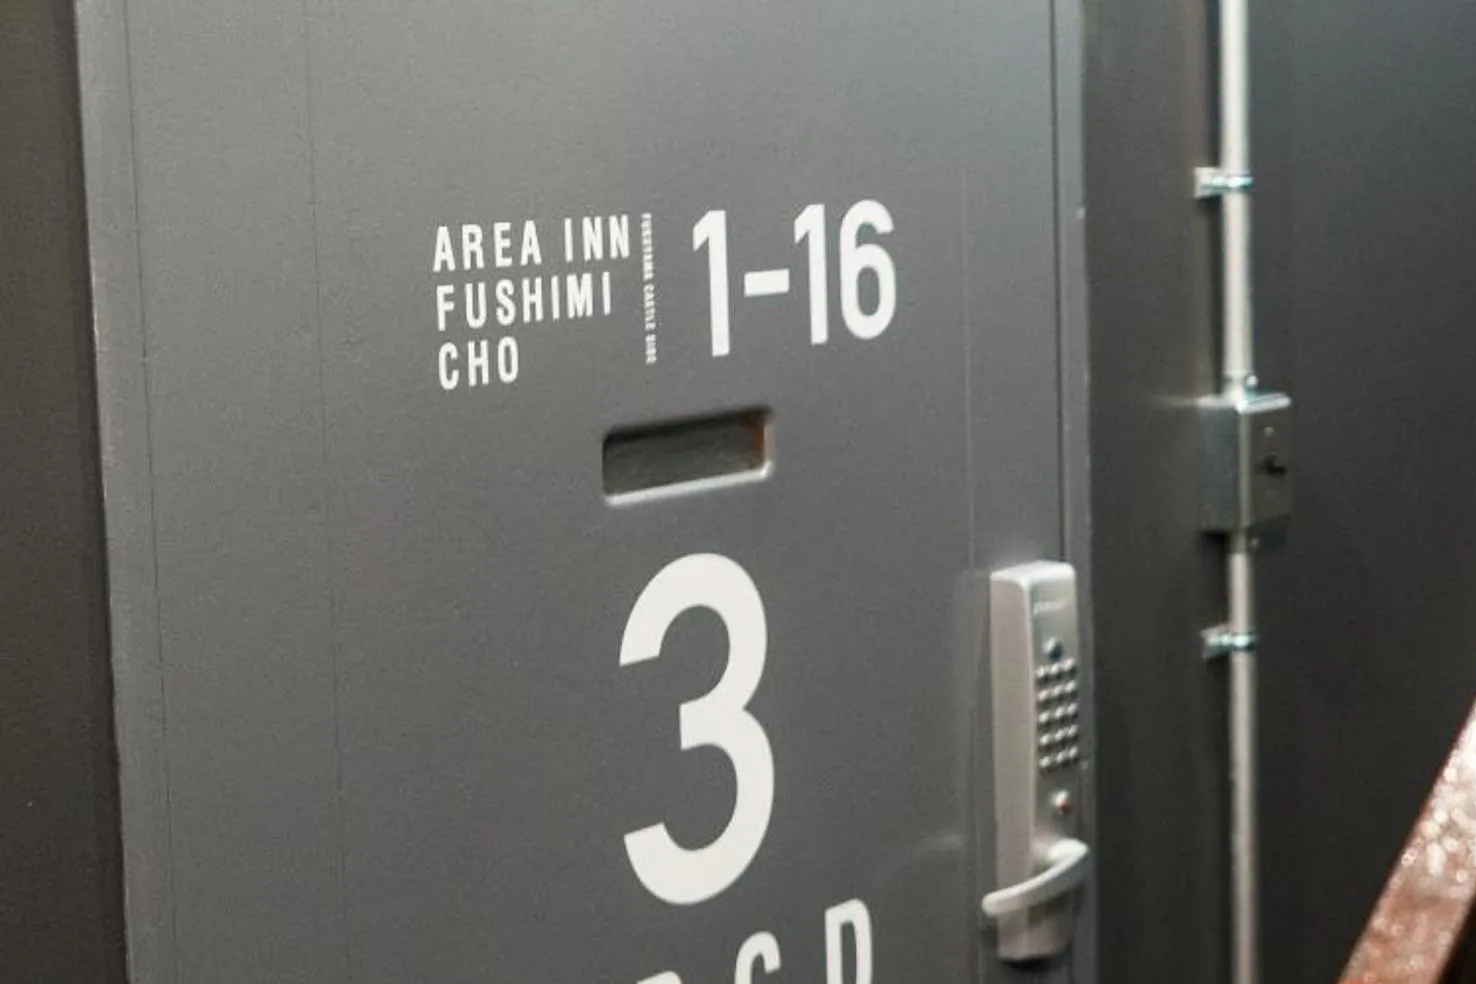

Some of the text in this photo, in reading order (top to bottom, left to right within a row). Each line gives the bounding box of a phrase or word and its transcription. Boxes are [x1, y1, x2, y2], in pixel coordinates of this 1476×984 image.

[432, 219, 543, 273] AREA
[563, 213, 631, 263] INN
[436, 271, 612, 332] FUSHIMI
[692, 199, 897, 357] 1-16
[438, 336, 519, 390] CHO
[619, 552, 775, 905] 3
